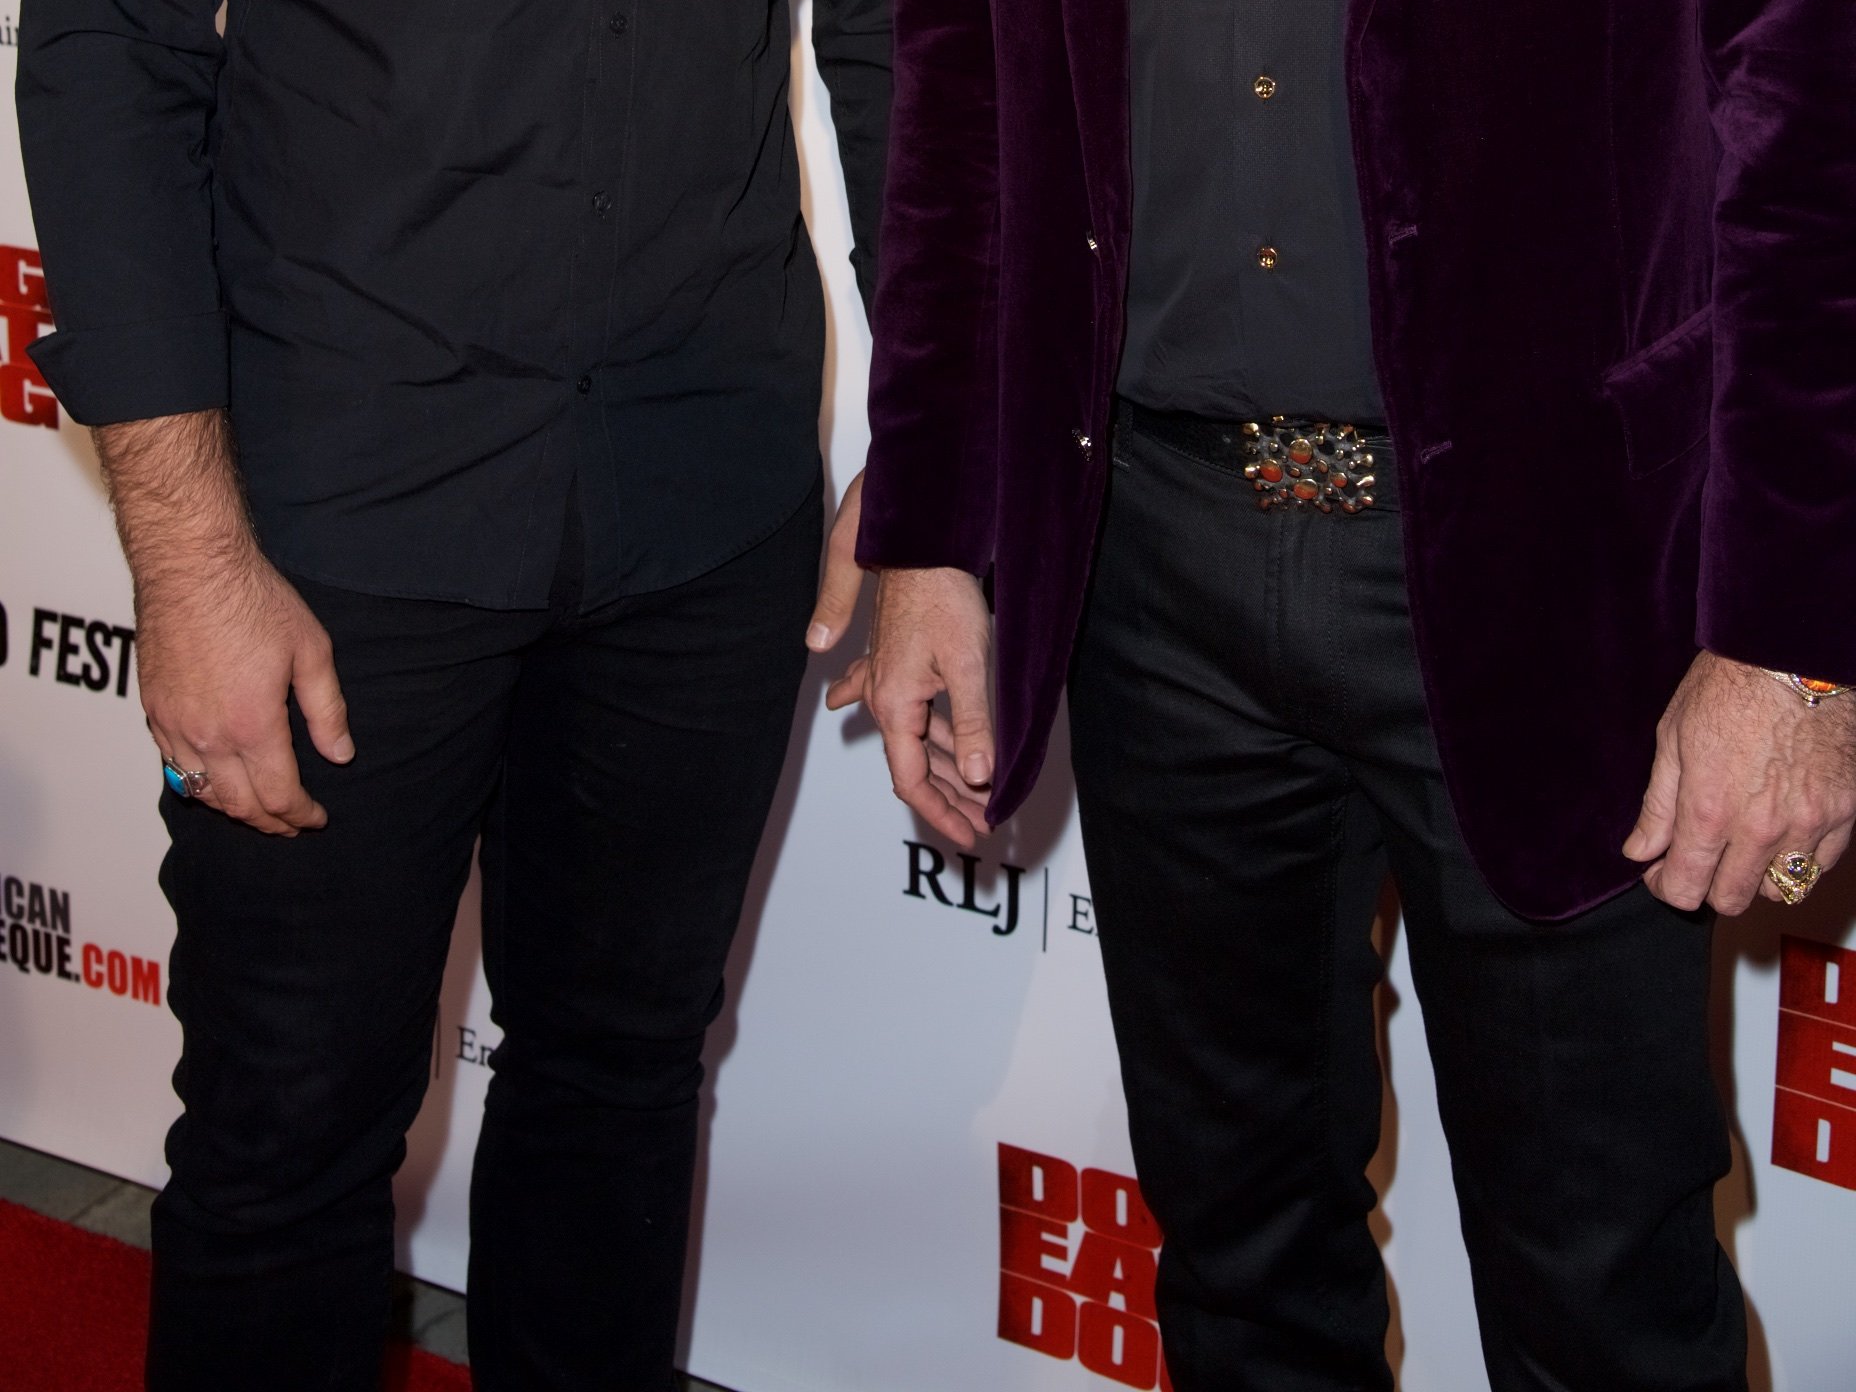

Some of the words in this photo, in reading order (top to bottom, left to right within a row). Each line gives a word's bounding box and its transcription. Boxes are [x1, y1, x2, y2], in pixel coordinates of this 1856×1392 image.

[29, 607, 136, 699] FEST
[0, 873, 71, 935] CAN
[902, 840, 1026, 936] RLJ
[1067, 893, 1100, 937] E
[997, 1269, 1174, 1392] DO
